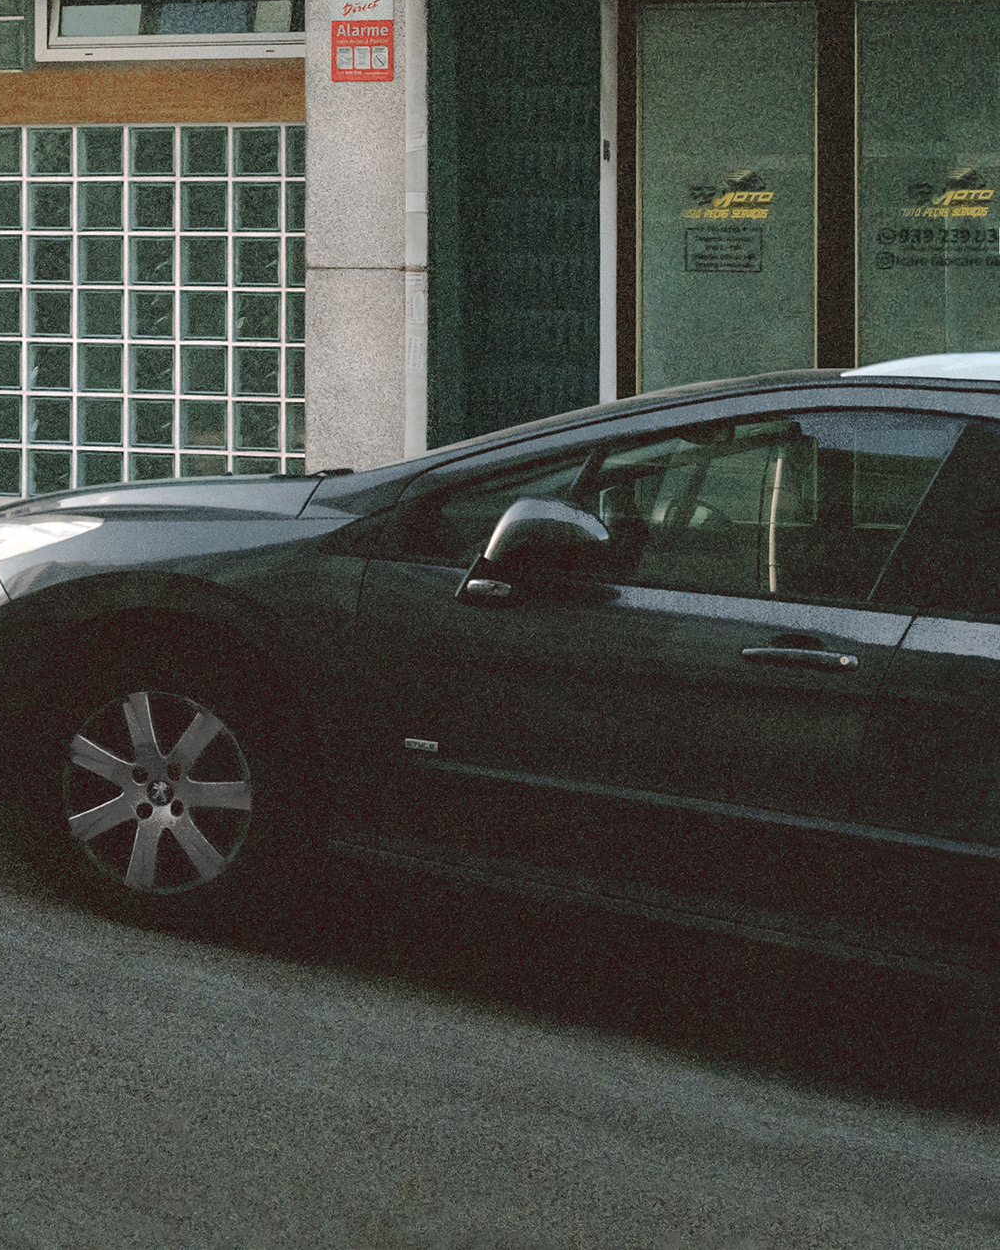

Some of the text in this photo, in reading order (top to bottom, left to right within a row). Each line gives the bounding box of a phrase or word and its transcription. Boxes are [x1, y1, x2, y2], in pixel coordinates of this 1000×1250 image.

[336, 23, 389, 37] Alarme
[713, 191, 775, 208] MOTO
[932, 189, 995, 206] MOTO
